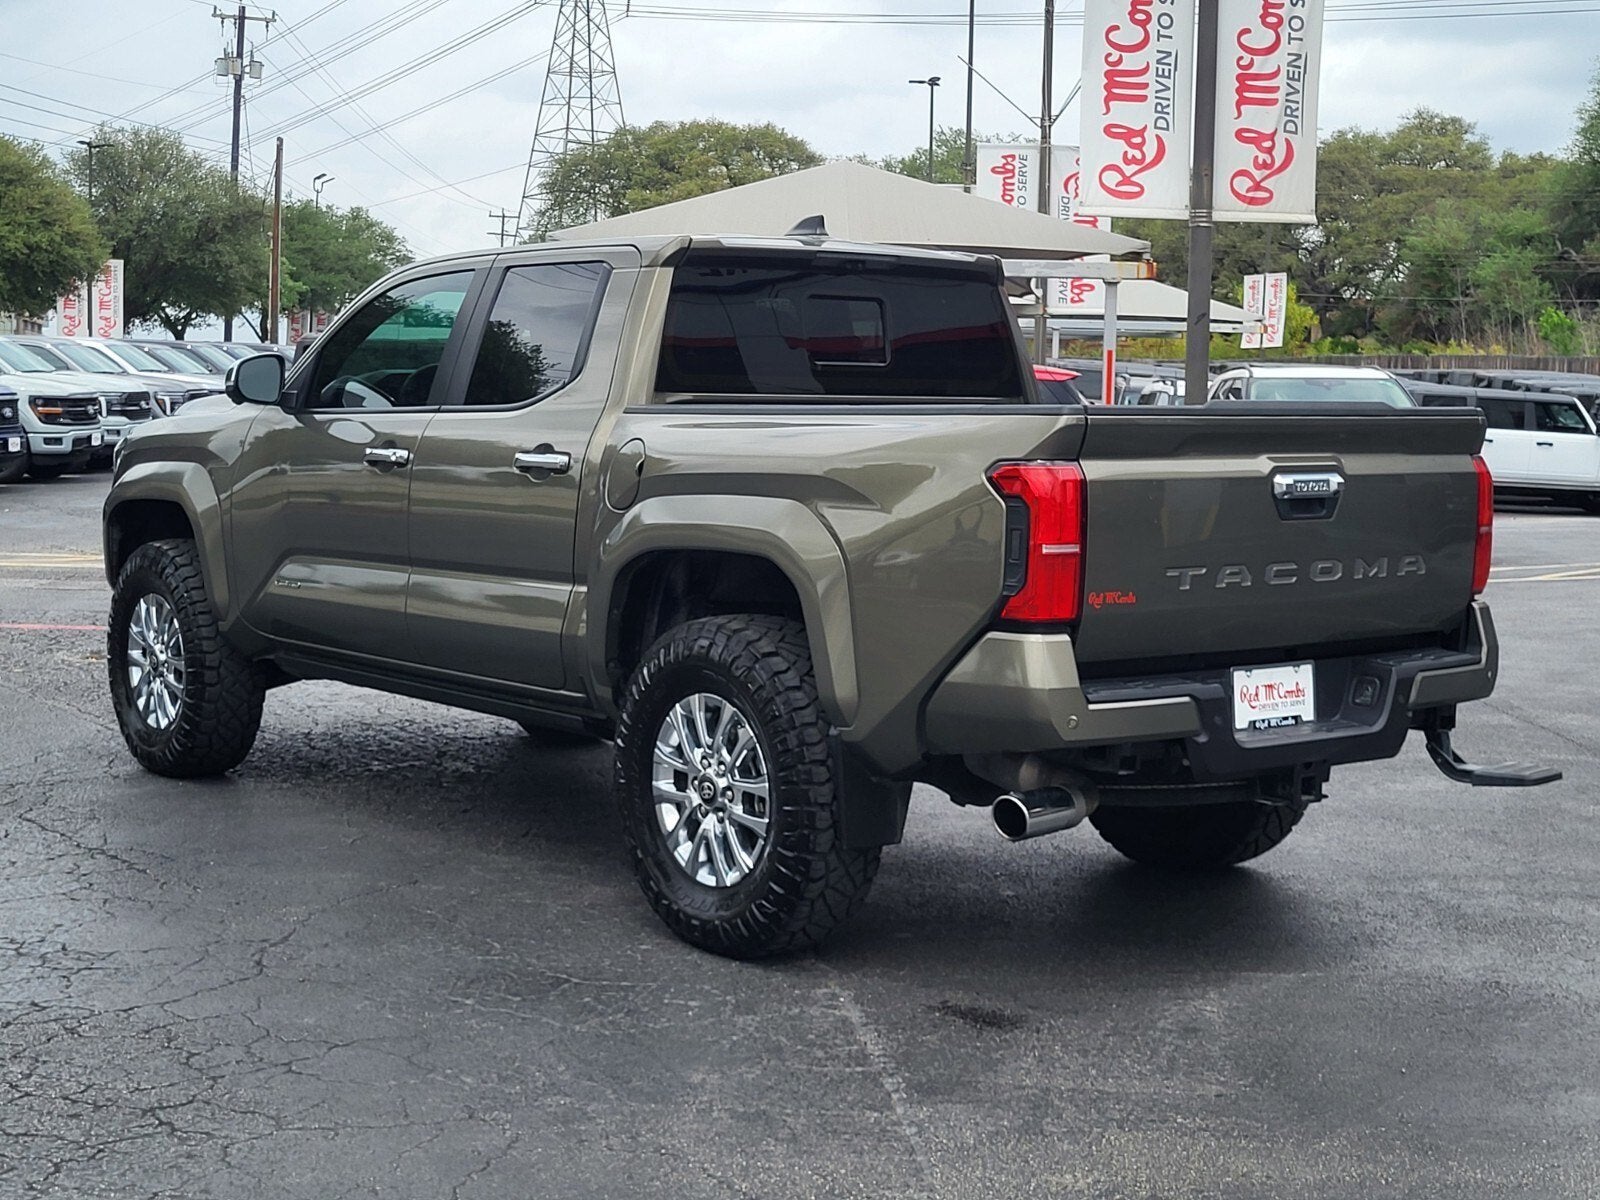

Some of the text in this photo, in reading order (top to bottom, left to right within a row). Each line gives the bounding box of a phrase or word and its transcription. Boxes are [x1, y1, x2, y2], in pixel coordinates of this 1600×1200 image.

[1157, 12, 1174, 42] TO
[1287, 15, 1304, 45] TO
[1153, 49, 1173, 132] DRIVEN
[1283, 52, 1303, 136] DRIVEN
[1017, 153, 1029, 192] SERVE
[1099, 123, 1166, 200] Red
[1230, 128, 1295, 206] Red
[62, 314, 81, 337] Red
[98, 315, 116, 338] Red
[1294, 481, 1330, 492] TOYOTA
[1165, 554, 1427, 591] TACOMA
[1239, 681, 1306, 709] Red McCombs
